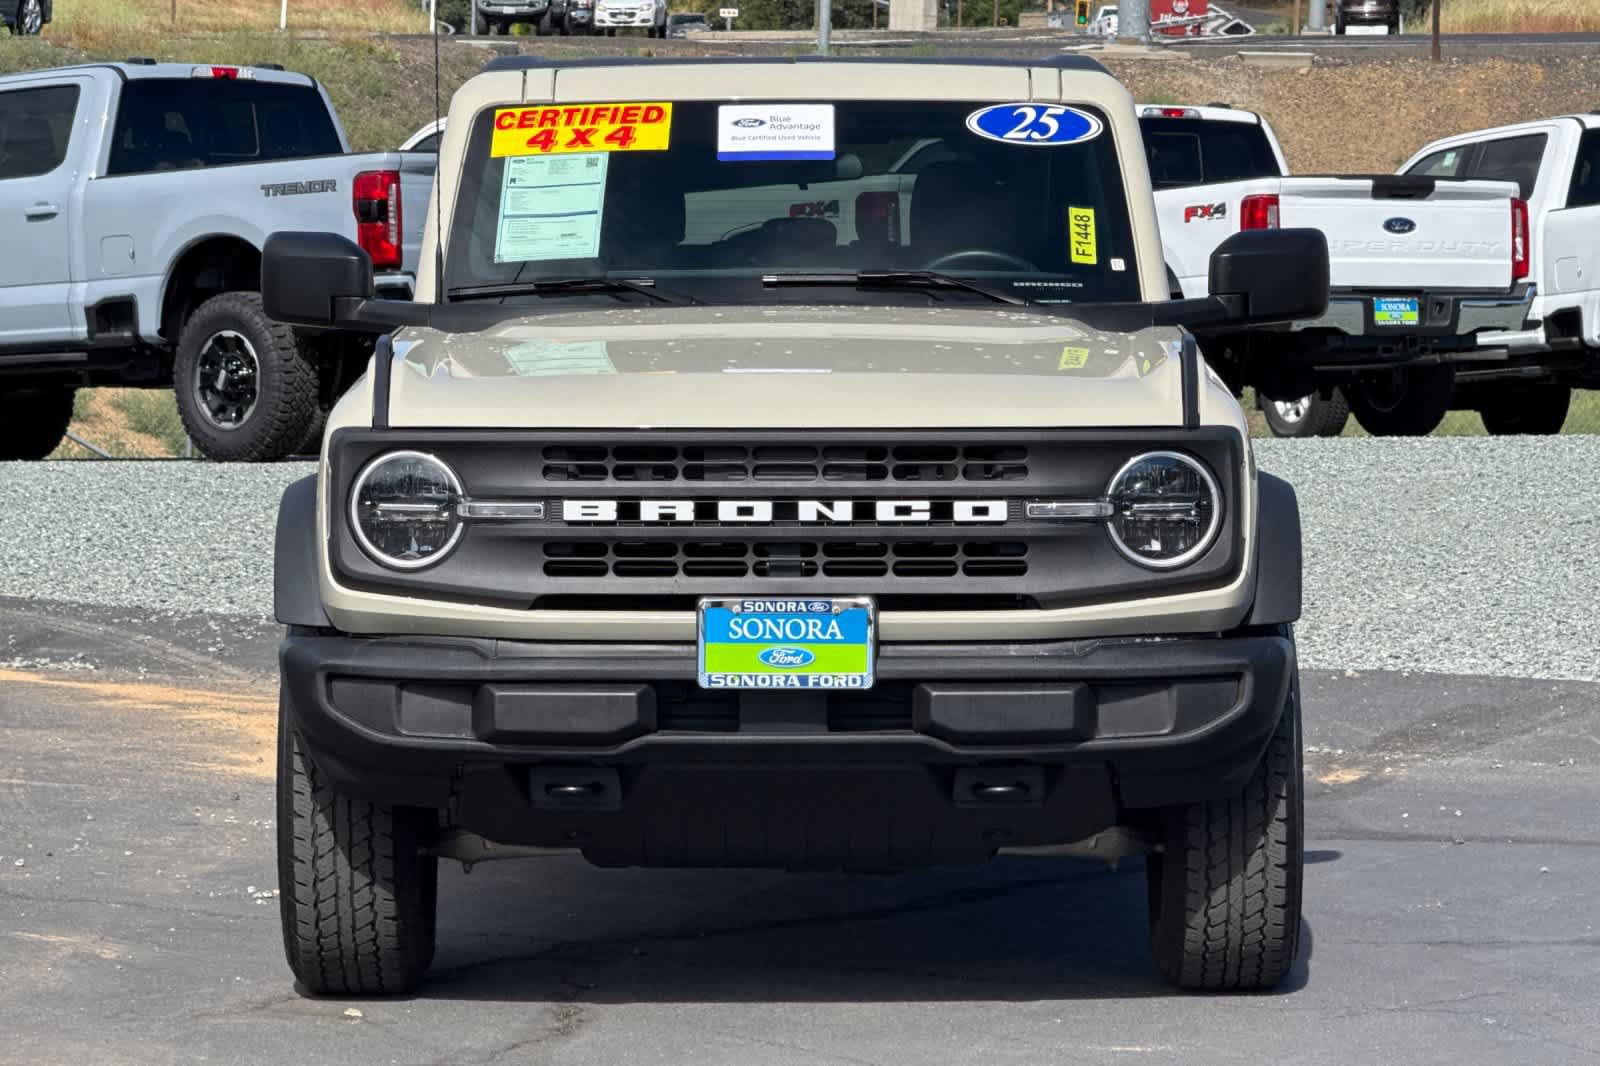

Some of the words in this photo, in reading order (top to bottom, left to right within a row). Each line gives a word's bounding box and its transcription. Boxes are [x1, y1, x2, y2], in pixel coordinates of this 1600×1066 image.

[495, 106, 665, 130] CERTIFIED
[769, 123, 821, 132] Advantage
[1002, 106, 1066, 140] 25
[260, 179, 337, 198] TREMOR
[1184, 202, 1227, 223] FX4
[1074, 214, 1093, 257] F1448
[562, 500, 1008, 521] BRONCO
[744, 601, 807, 612] SONORA
[728, 618, 844, 640] SONORA
[768, 647, 805, 665] Ford
[711, 675, 800, 687] SONORA
[808, 674, 862, 687] FORD
